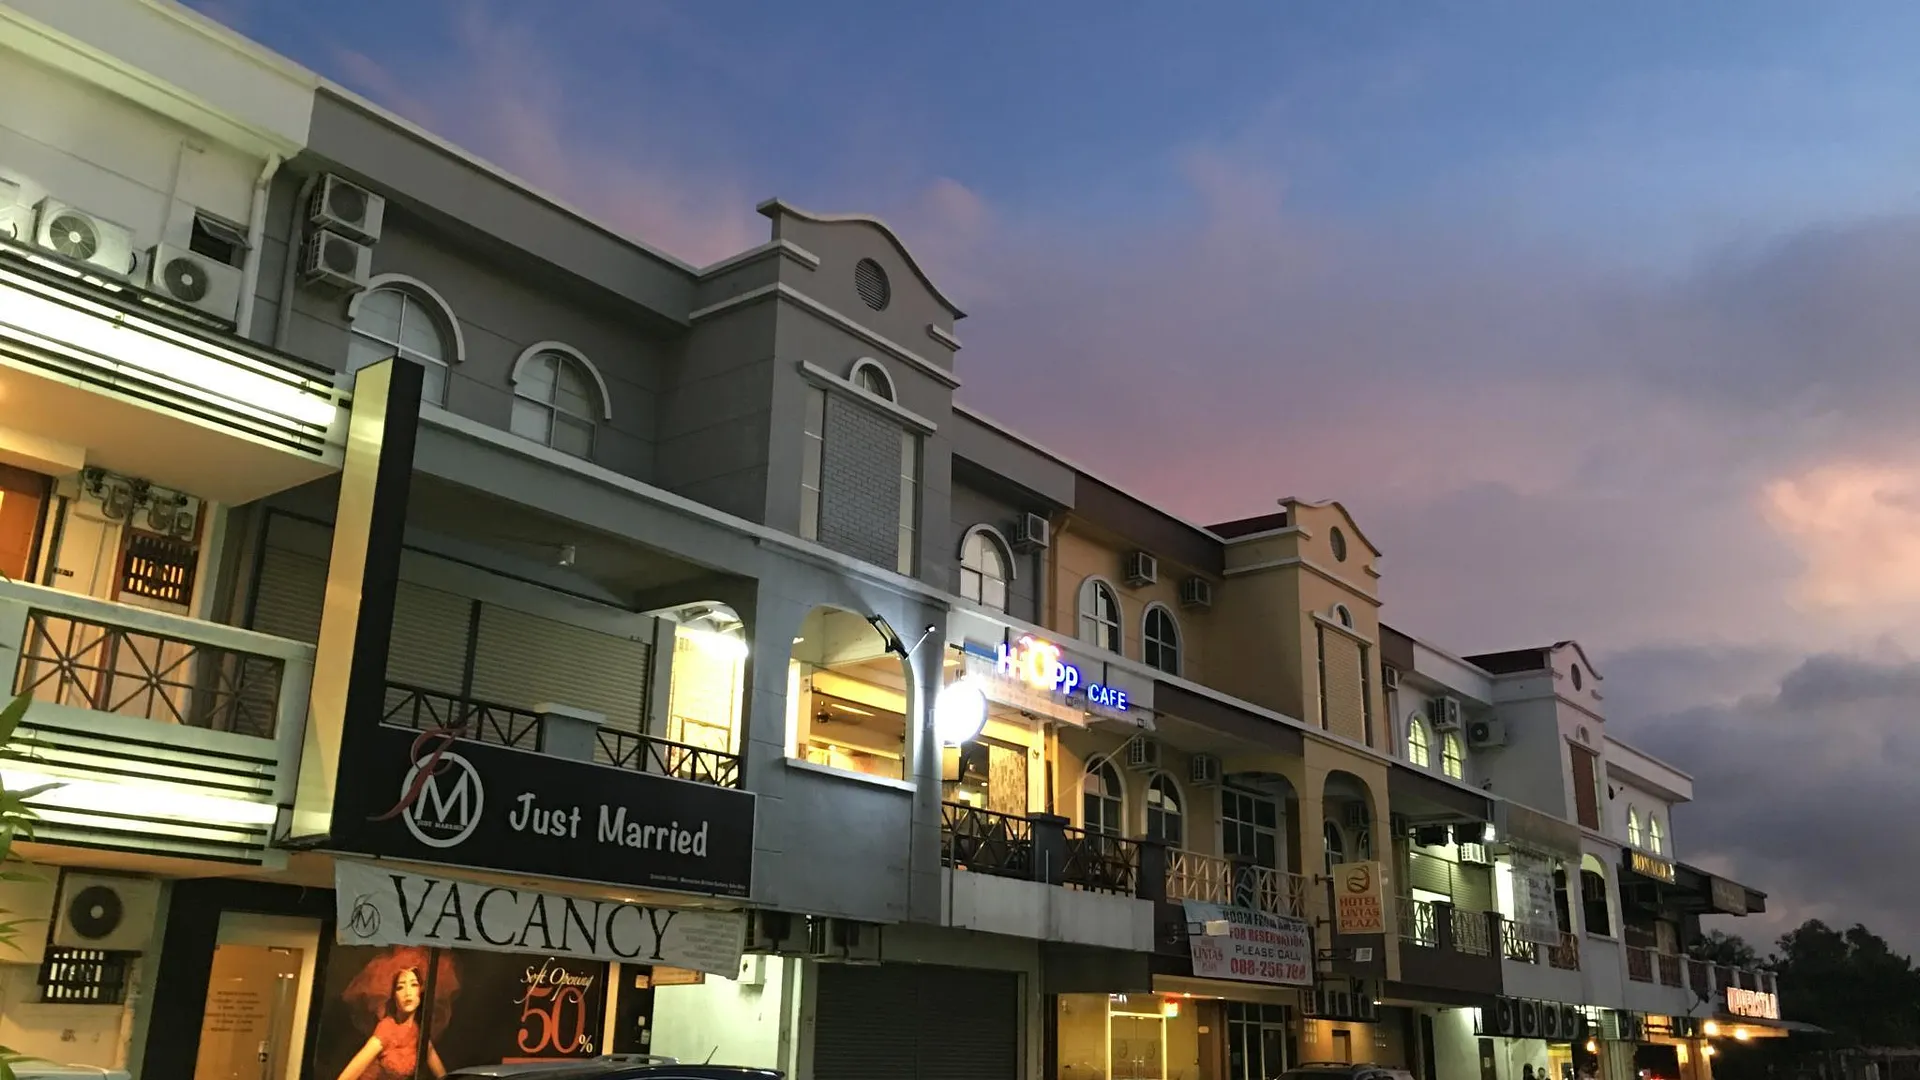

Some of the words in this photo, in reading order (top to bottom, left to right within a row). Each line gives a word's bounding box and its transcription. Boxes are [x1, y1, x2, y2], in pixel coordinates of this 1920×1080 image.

[1088, 683, 1127, 711] CAFE
[509, 792, 581, 839] Just
[598, 804, 708, 858] Married
[1339, 897, 1379, 907] HOTEL
[389, 874, 679, 961] VACANCY
[1223, 909, 1252, 925] ROOM
[1341, 907, 1380, 918] LINTAS
[1341, 918, 1380, 929] PLAZA
[1230, 928, 1246, 940] FOR
[1235, 945, 1274, 958] PLEASE
[513, 957, 555, 1004] Soft
[549, 967, 594, 1004] Opening
